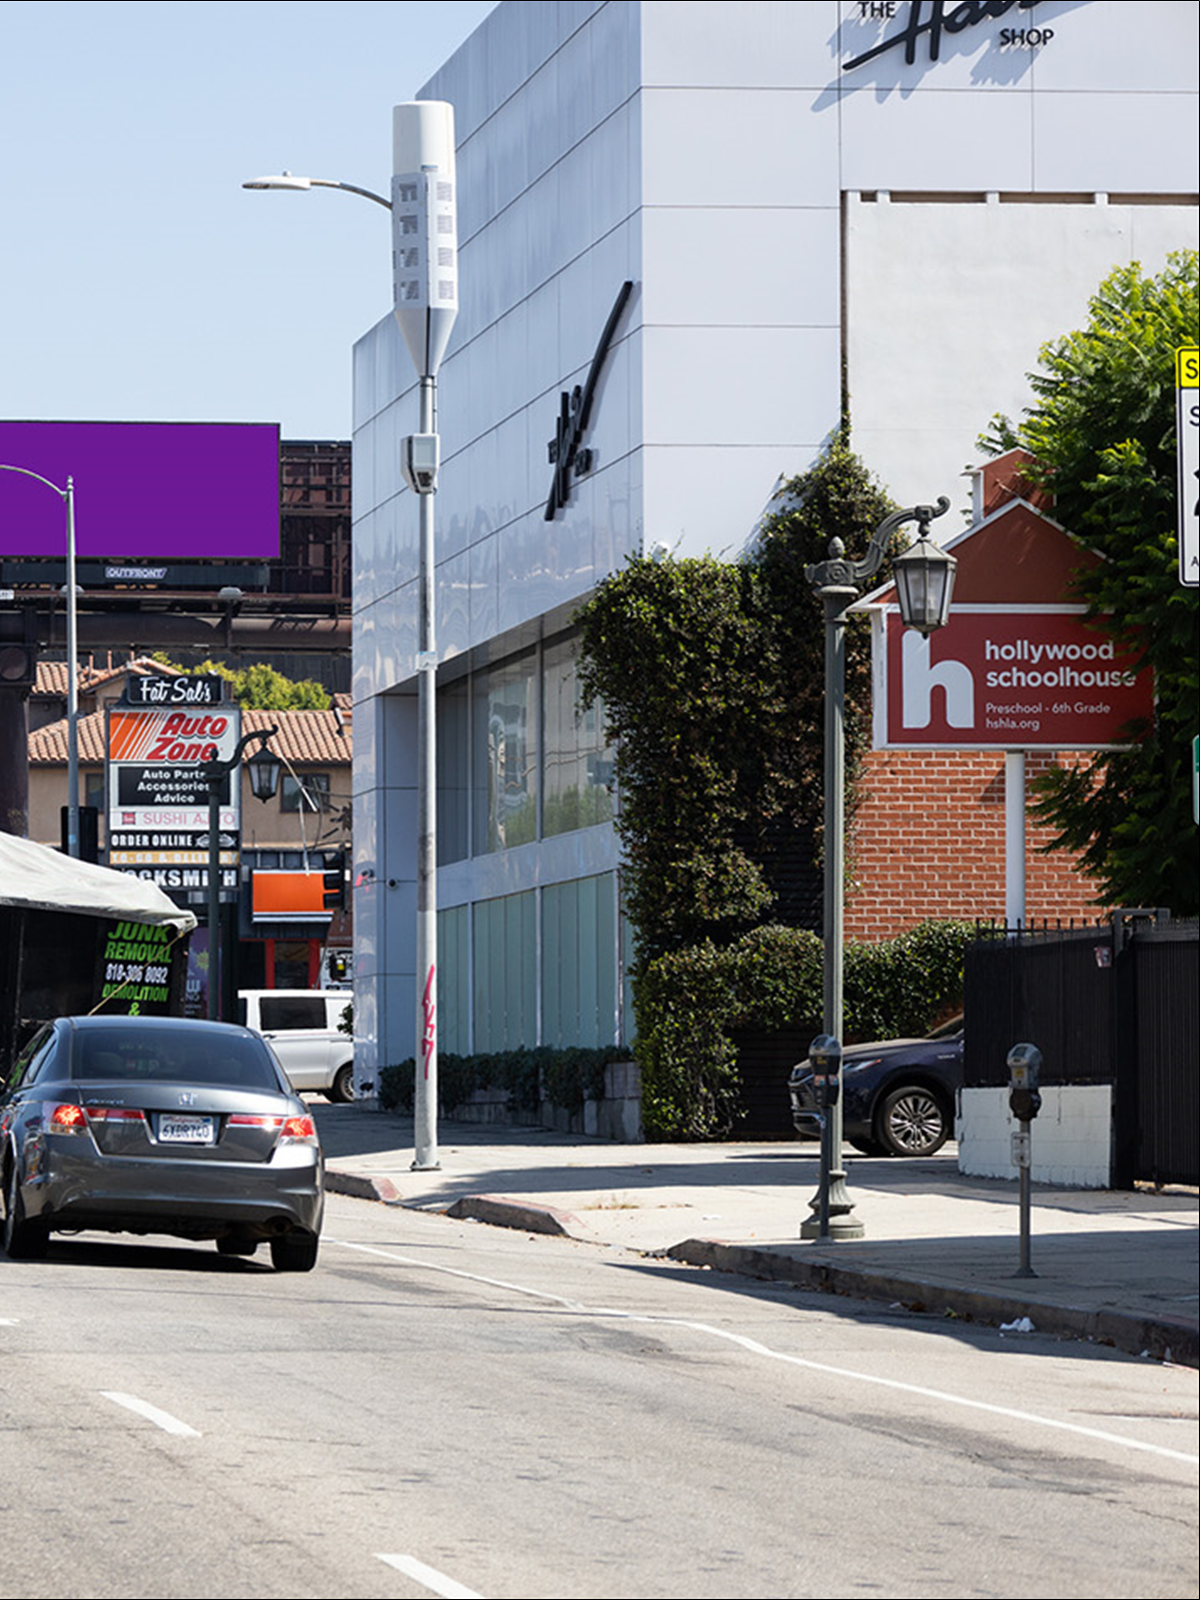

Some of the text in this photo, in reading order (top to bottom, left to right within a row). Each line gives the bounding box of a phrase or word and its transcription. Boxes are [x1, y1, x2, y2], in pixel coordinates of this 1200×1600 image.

[859, 1, 896, 18] THE
[999, 28, 1054, 47] SHOP
[985, 640, 1114, 664] hollywood
[902, 629, 974, 729] h
[986, 667, 1136, 687] schoolhouse
[140, 676, 211, 702] Fat Sal's
[986, 702, 1042, 714] Preschool
[1052, 703, 1072, 714] 6th
[1074, 702, 1111, 714] Grade
[160, 712, 228, 736] Auto
[986, 717, 1040, 730] hshla.org
[145, 737, 218, 761] Zone
[143, 770, 171, 779] Auto
[154, 793, 195, 803] Advice
[143, 813, 187, 825] SUSHI
[111, 834, 192, 846] ORDER ONLINE
[123, 870, 237, 886] CKSMIH
[108, 922, 172, 943] JUNK
[104, 941, 172, 963] REMOVAL
[102, 983, 169, 1003] DEMOLITION
[128, 1002, 140, 1016] &
